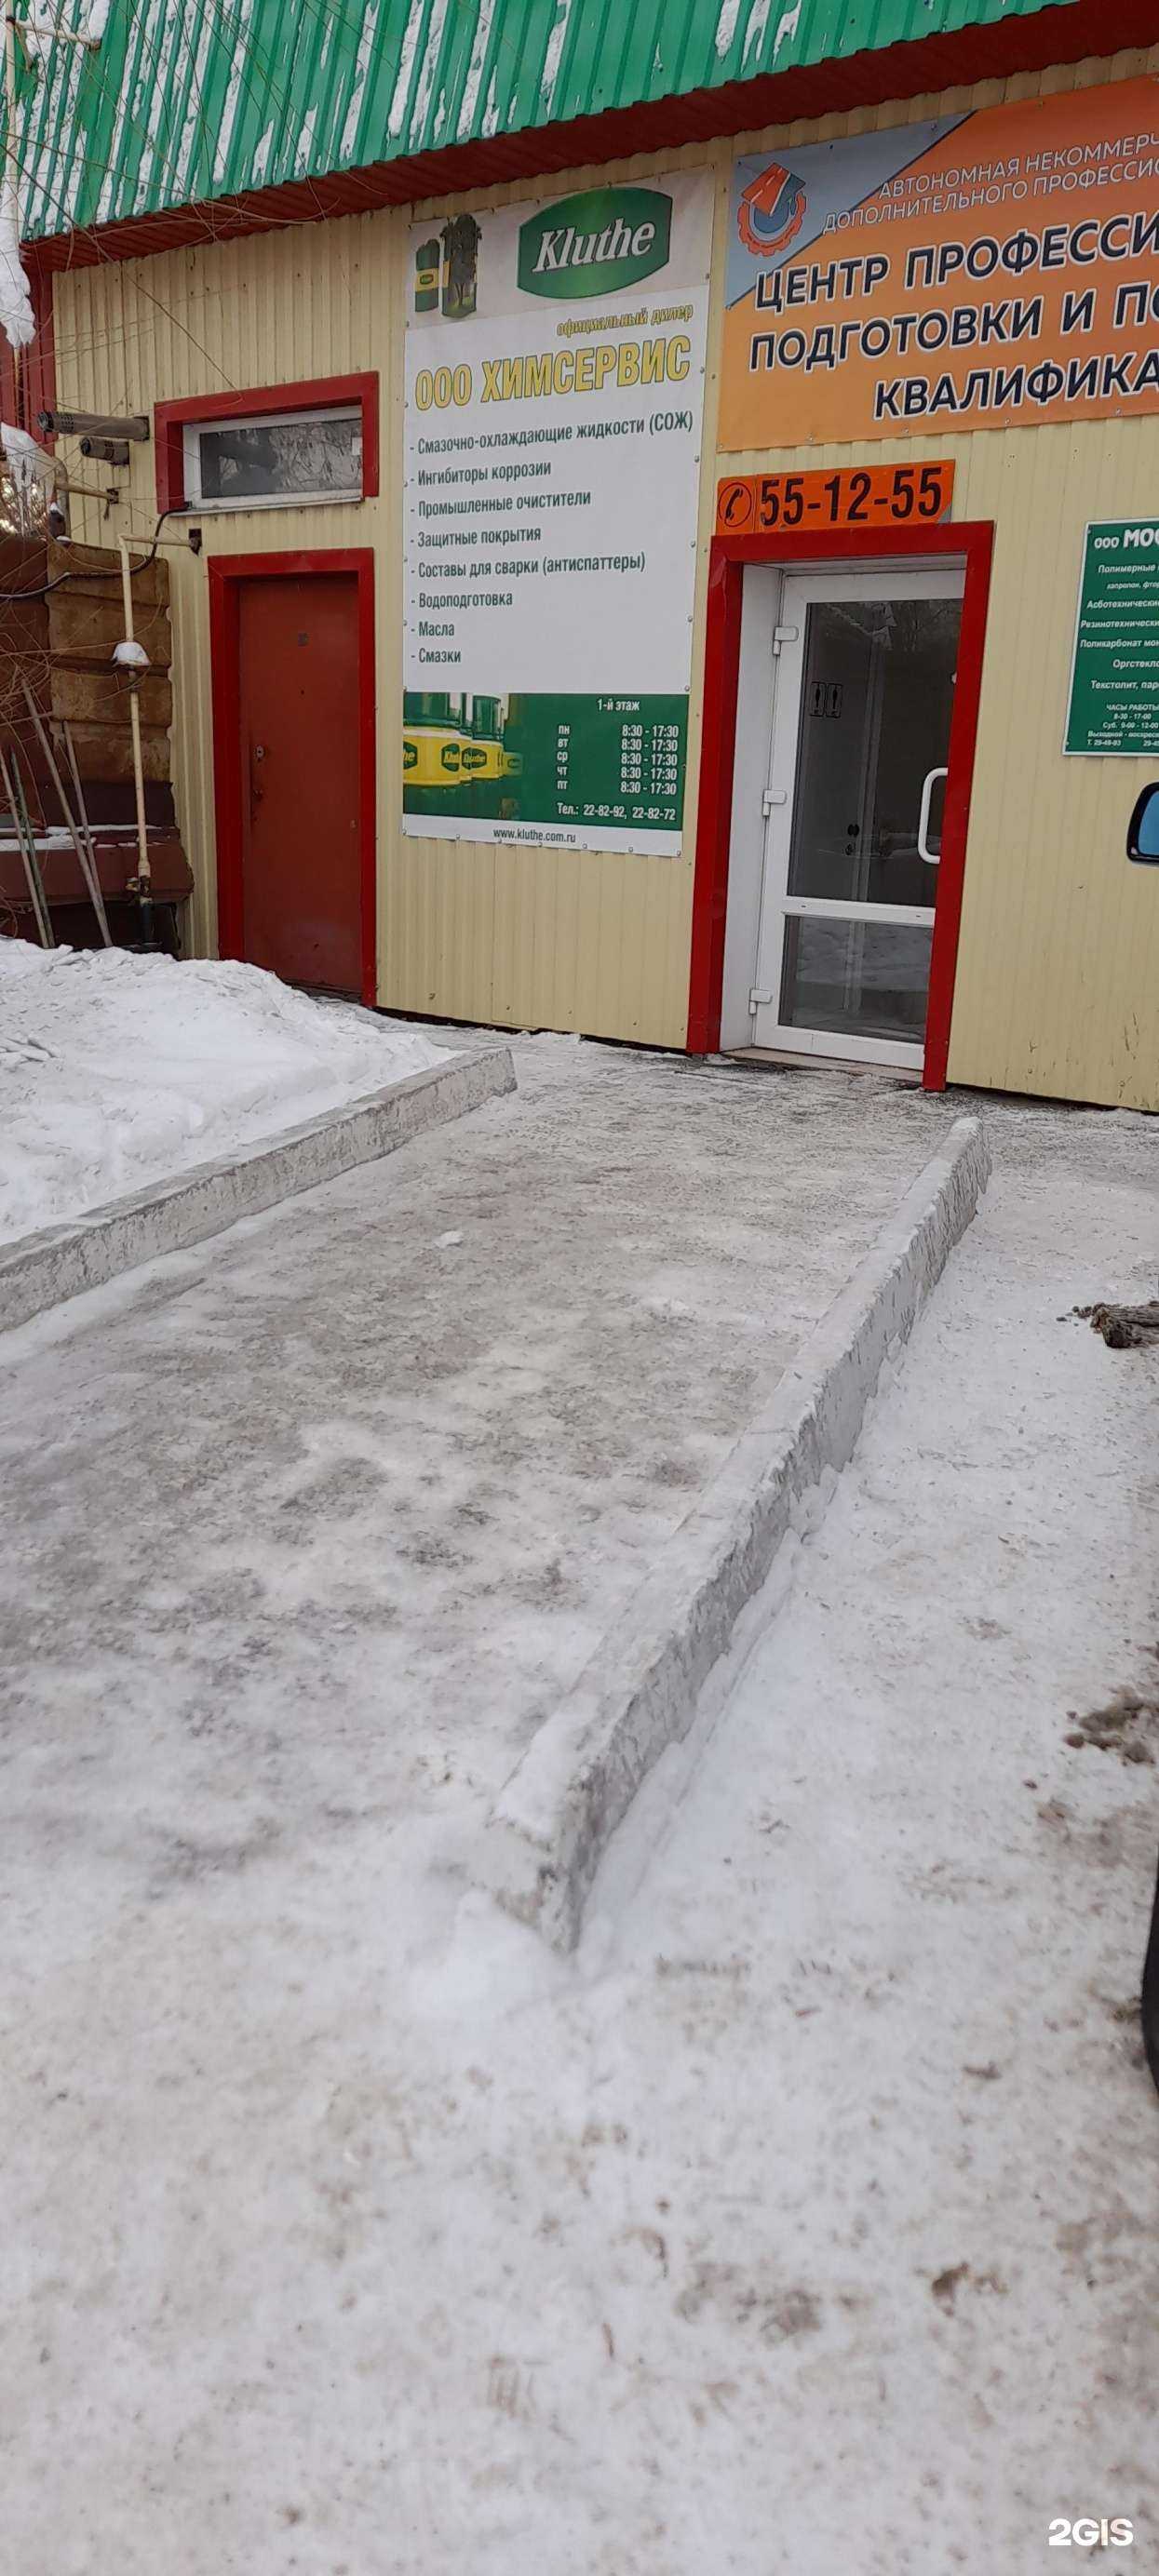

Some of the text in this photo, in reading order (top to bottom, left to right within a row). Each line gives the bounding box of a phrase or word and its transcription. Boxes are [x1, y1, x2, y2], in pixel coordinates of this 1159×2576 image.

[879, 157, 1020, 199] АВТОНОМНАЯ
[822, 181, 1028, 235] ДОПОЛНИТЕЛЬНОГО
[532, 218, 656, 274] Kluthe
[754, 255, 889, 315] ЦЕНТР
[557, 304, 694, 338] официальный дилер
[749, 279, 1159, 371] ПОДГОТОВКИ И П
[415, 335, 691, 410] ООО ХИМСЕРВИС
[418, 427, 573, 454] Смазочно-охлаждающие
[576, 417, 644, 439] жидкости
[649, 410, 694, 436] (СОЖ)
[418, 464, 489, 487] Ингибиторы
[492, 462, 551, 483] коррозии
[418, 496, 513, 520] Промышленные
[517, 491, 591, 511] очистители
[760, 466, 943, 527] 55-12-55
[417, 531, 478, 549] Защитные
[481, 528, 542, 545] покрытия
[418, 561, 466, 579] Составы
[470, 562, 492, 577] для
[495, 559, 538, 576] сварки
[543, 551, 646, 576] (антиспаттеры)
[419, 592, 513, 610] Водоподготовка
[419, 621, 455, 637] Масла
[419, 648, 461, 664] Смазки
[597, 698, 640, 711] 1-й этаж
[558, 725, 570, 734] пн
[622, 724, 642, 737] 8:30
[652, 725, 680, 738] 17:30
[558, 738, 569, 748] вт
[621, 738, 642, 750] 8:30
[652, 739, 679, 752] 17:30
[557, 751, 568, 763] ср
[621, 752, 641, 765] 8:30
[652, 753, 678, 766] 17:30
[557, 766, 568, 776] чт
[621, 766, 641, 779] 8:30
[651, 768, 678, 781] 17:30
[557, 780, 568, 790] пт
[620, 781, 641, 793] 8:30
[651, 783, 677, 795] 17:30
[557, 802, 676, 821] Тел.: 22-82-92, 22-82-72
[492, 827, 576, 843] www.kluthe.com.ru
